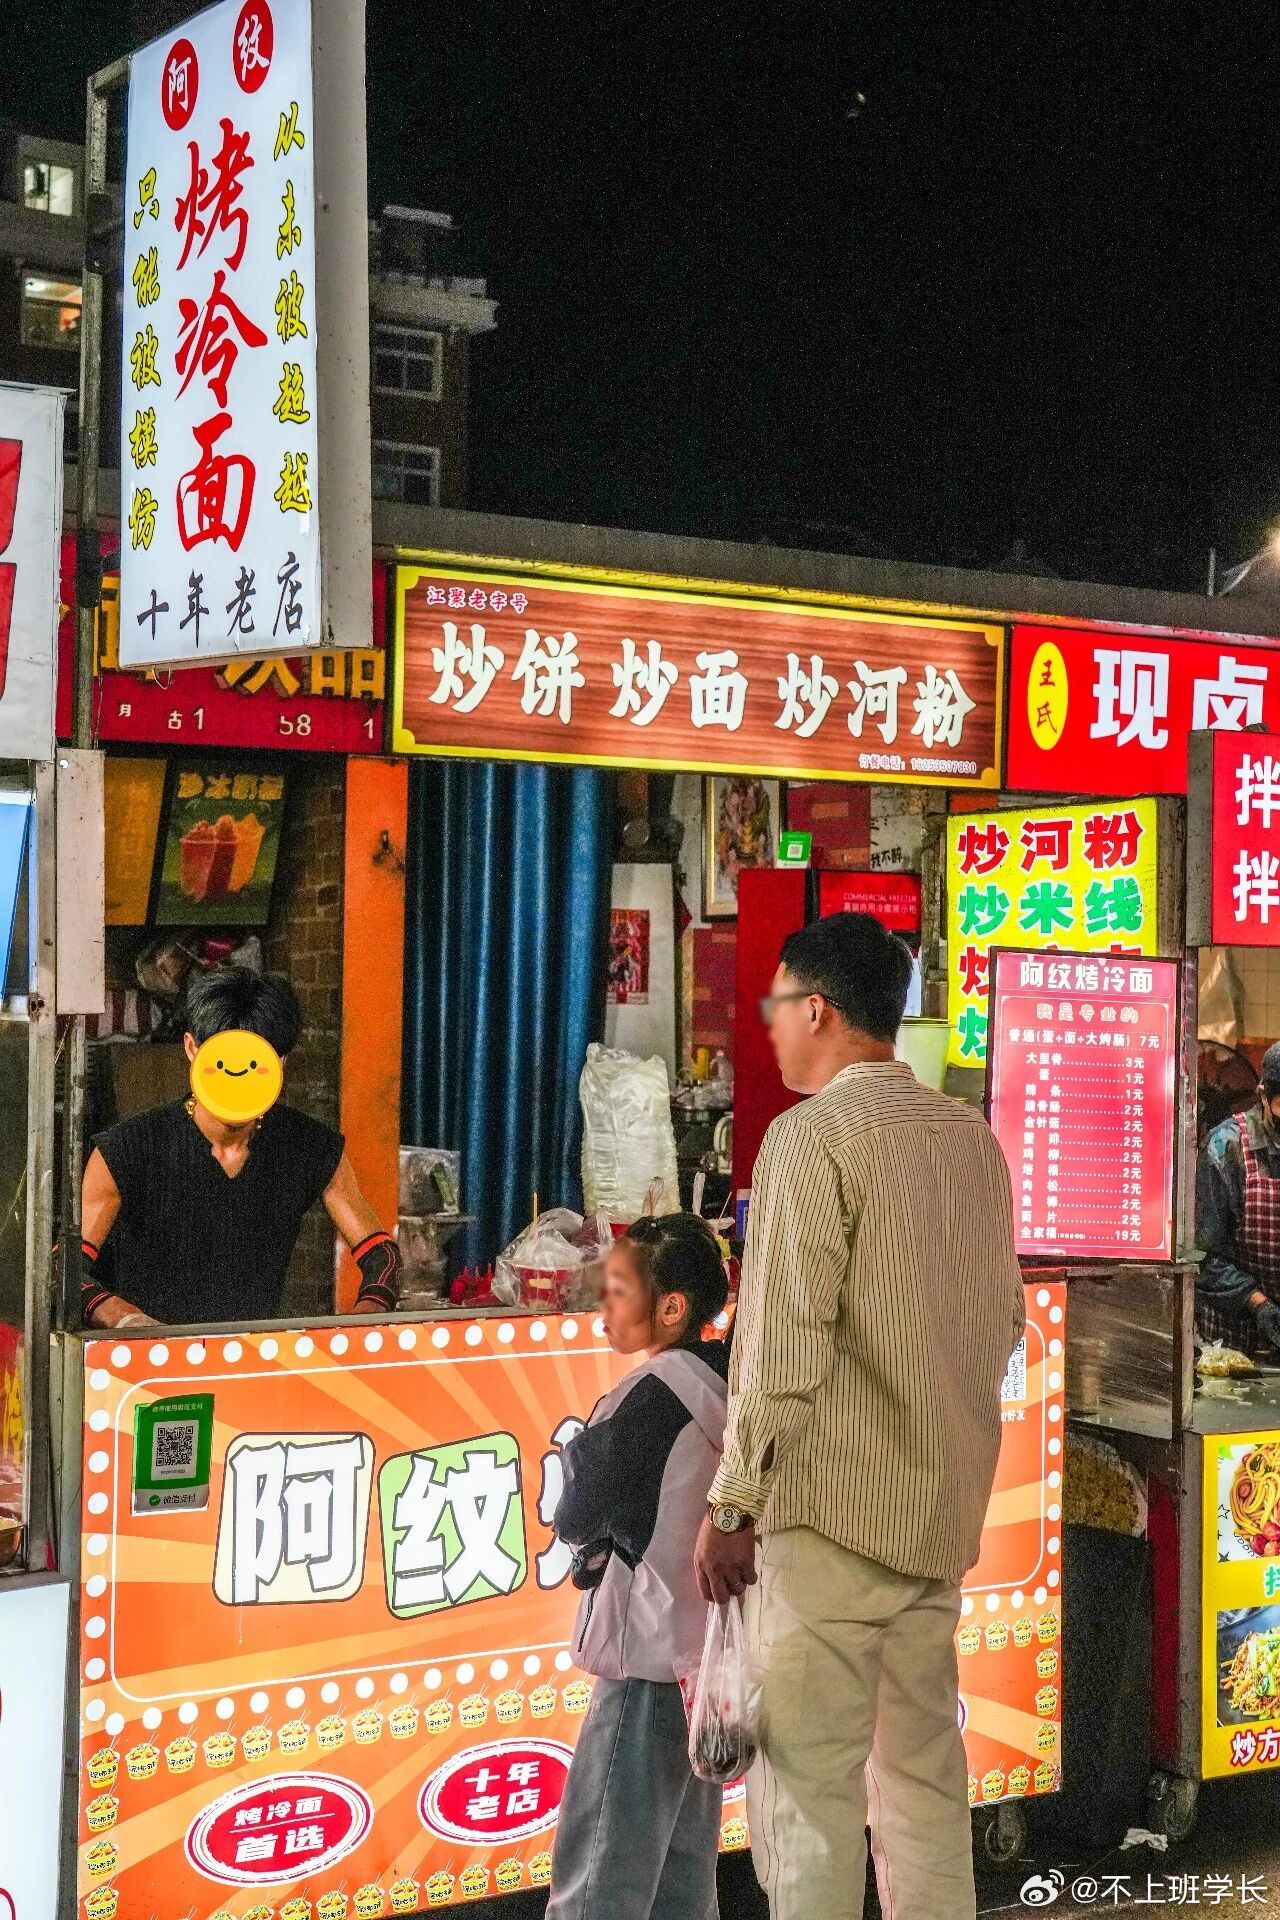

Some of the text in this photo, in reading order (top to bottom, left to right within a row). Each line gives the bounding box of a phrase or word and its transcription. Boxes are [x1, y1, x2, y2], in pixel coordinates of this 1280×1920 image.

[273, 101, 311, 514] 从未被超越
[174, 117, 268, 553] 烤冷面
[129, 168, 161, 551] 只能被模仿
[137, 551, 303, 648] 十年老店
[428, 621, 976, 749] 炒饼 炒面 炒河粉
[1035, 660, 1058, 734] 王氏
[957, 812, 1144, 875] 炒河粉
[957, 877, 1144, 936] 炒米线
[1020, 961, 1153, 993] 阿纹烤冷面
[1037, 1003, 1139, 1023] 我是专业的
[1140, 1034, 1160, 1048] 7元
[1126, 1057, 1144, 1069] 3元
[1126, 1073, 1144, 1084] 1元
[1125, 1089, 1144, 1100] 1元
[1124, 1105, 1143, 1116] 2元
[1024, 1116, 1143, 1132] 金针菇 2元
[1124, 1136, 1143, 1148] 2元
[1123, 1152, 1142, 1163] 2元
[1123, 1168, 1142, 1179] 2元
[1122, 1183, 1142, 1195] 2元
[1122, 1199, 1141, 1210] 2元
[1121, 1214, 1141, 1226] 2元
[1020, 1226, 1057, 1239] 全家福
[1115, 1230, 1141, 1242] 19元
[464, 1761, 540, 1793] 十年
[234, 1796, 325, 1827] 烤冷面
[466, 1788, 541, 1821] 老店
[234, 1824, 327, 1863] 首选
